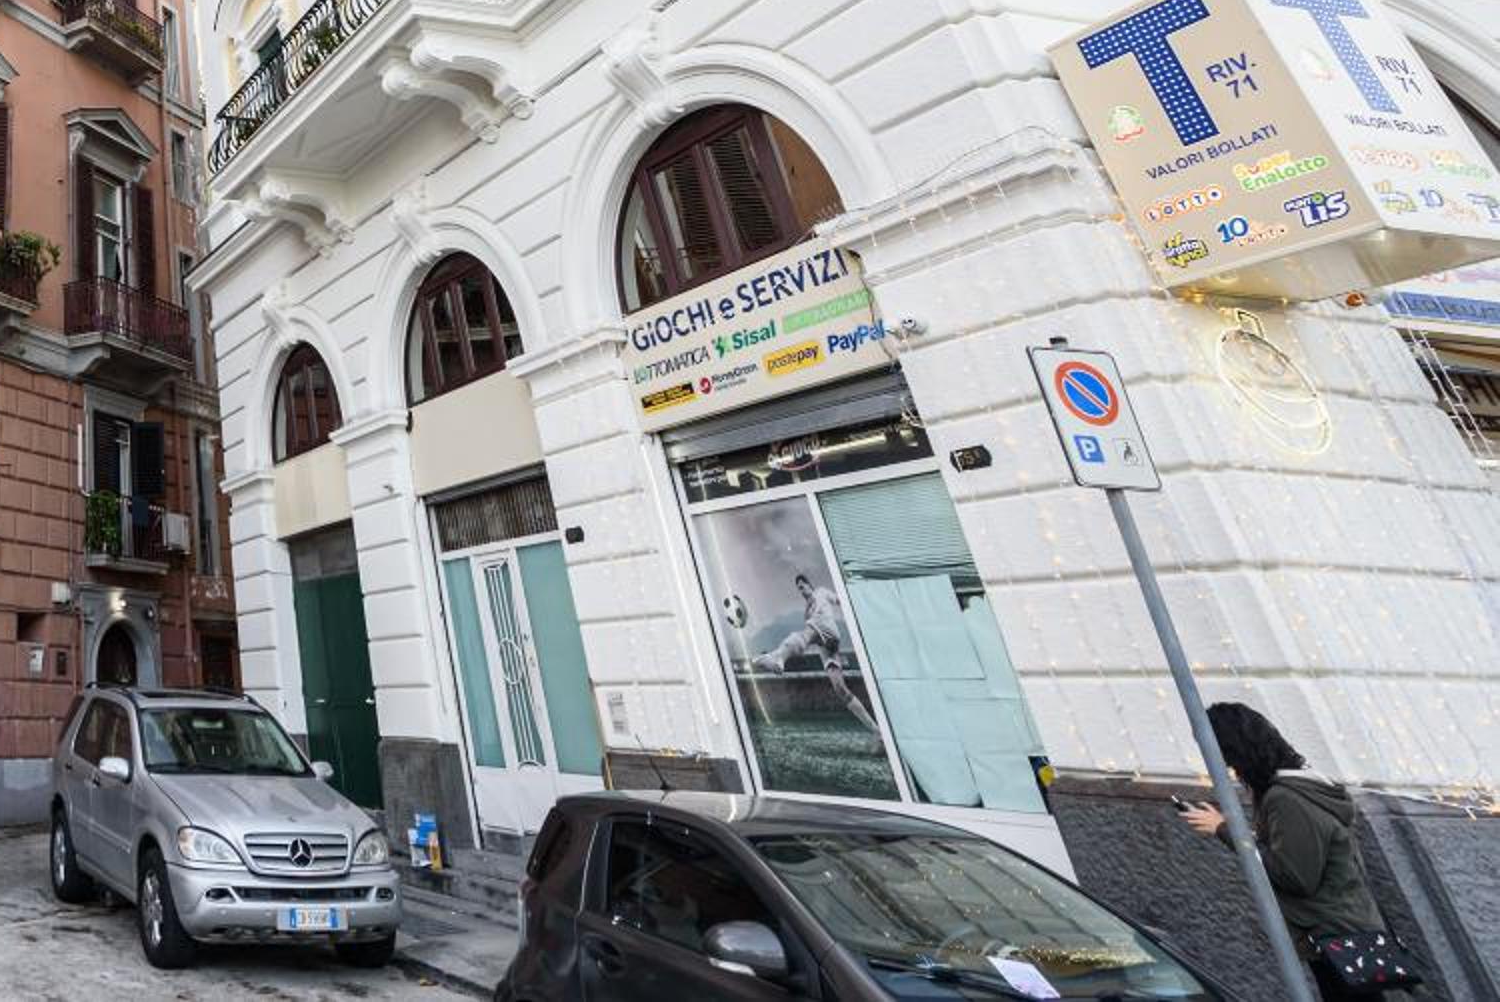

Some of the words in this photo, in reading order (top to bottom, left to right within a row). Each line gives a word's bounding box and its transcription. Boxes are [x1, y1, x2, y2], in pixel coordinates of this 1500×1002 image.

[1205, 52, 1257, 83] RIV.
[1225, 74, 1260, 99] 71
[1395, 75, 1423, 96] 71
[1145, 151, 1204, 179] VALORI
[1206, 123, 1279, 160] BOLLATI
[1242, 155, 1328, 191] Enalotto
[1217, 217, 1249, 243] 10
[719, 297, 736, 320] e
[736, 248, 850, 313] SERVIZI
[732, 319, 777, 350] Sisal
[826, 319, 886, 354] PayPal
